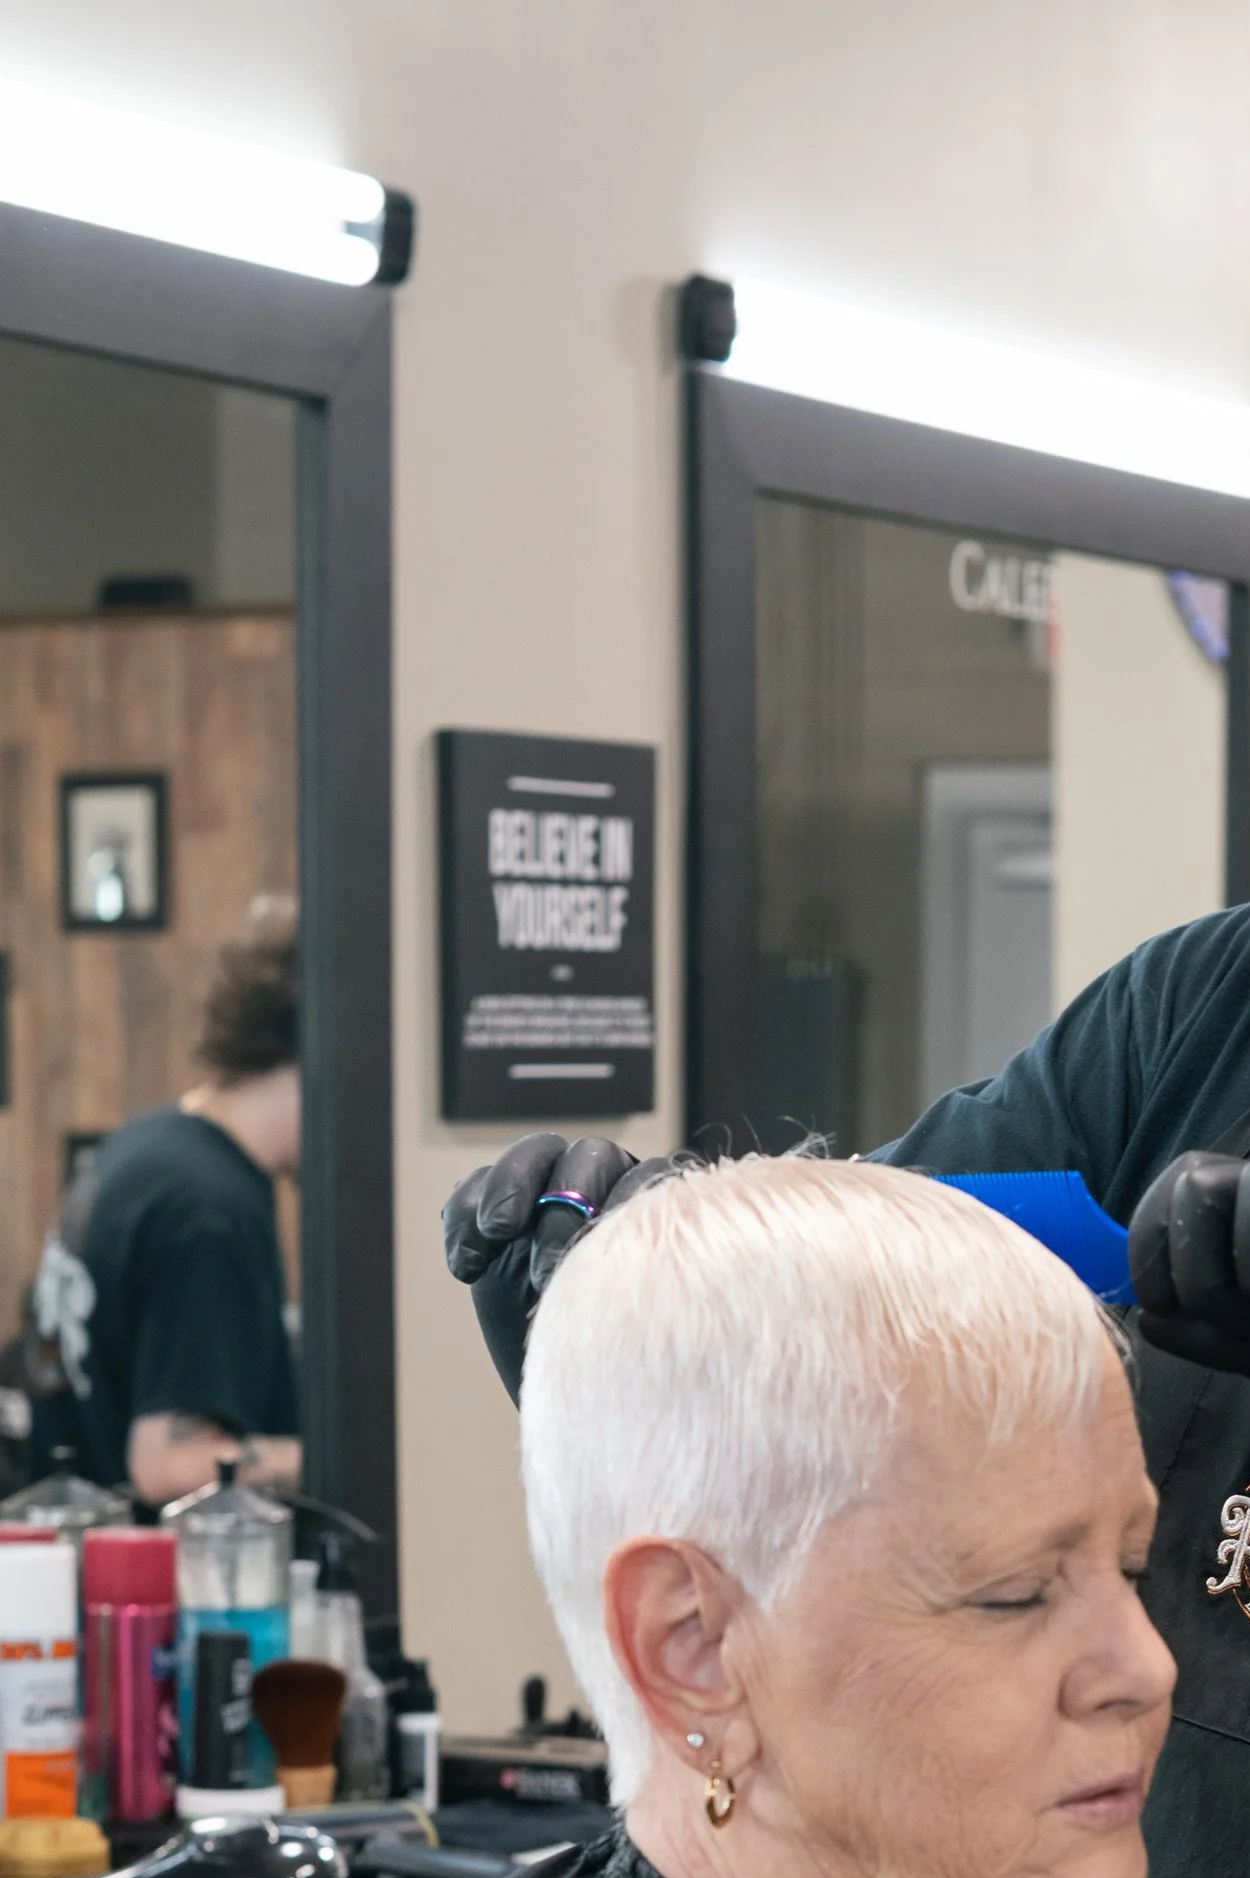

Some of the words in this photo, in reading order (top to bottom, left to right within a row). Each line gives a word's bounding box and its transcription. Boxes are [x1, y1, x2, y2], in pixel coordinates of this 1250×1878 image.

[488, 808, 600, 880] BELIEVE
[604, 816, 633, 882] IN
[491, 884, 628, 950] YOURSELF
